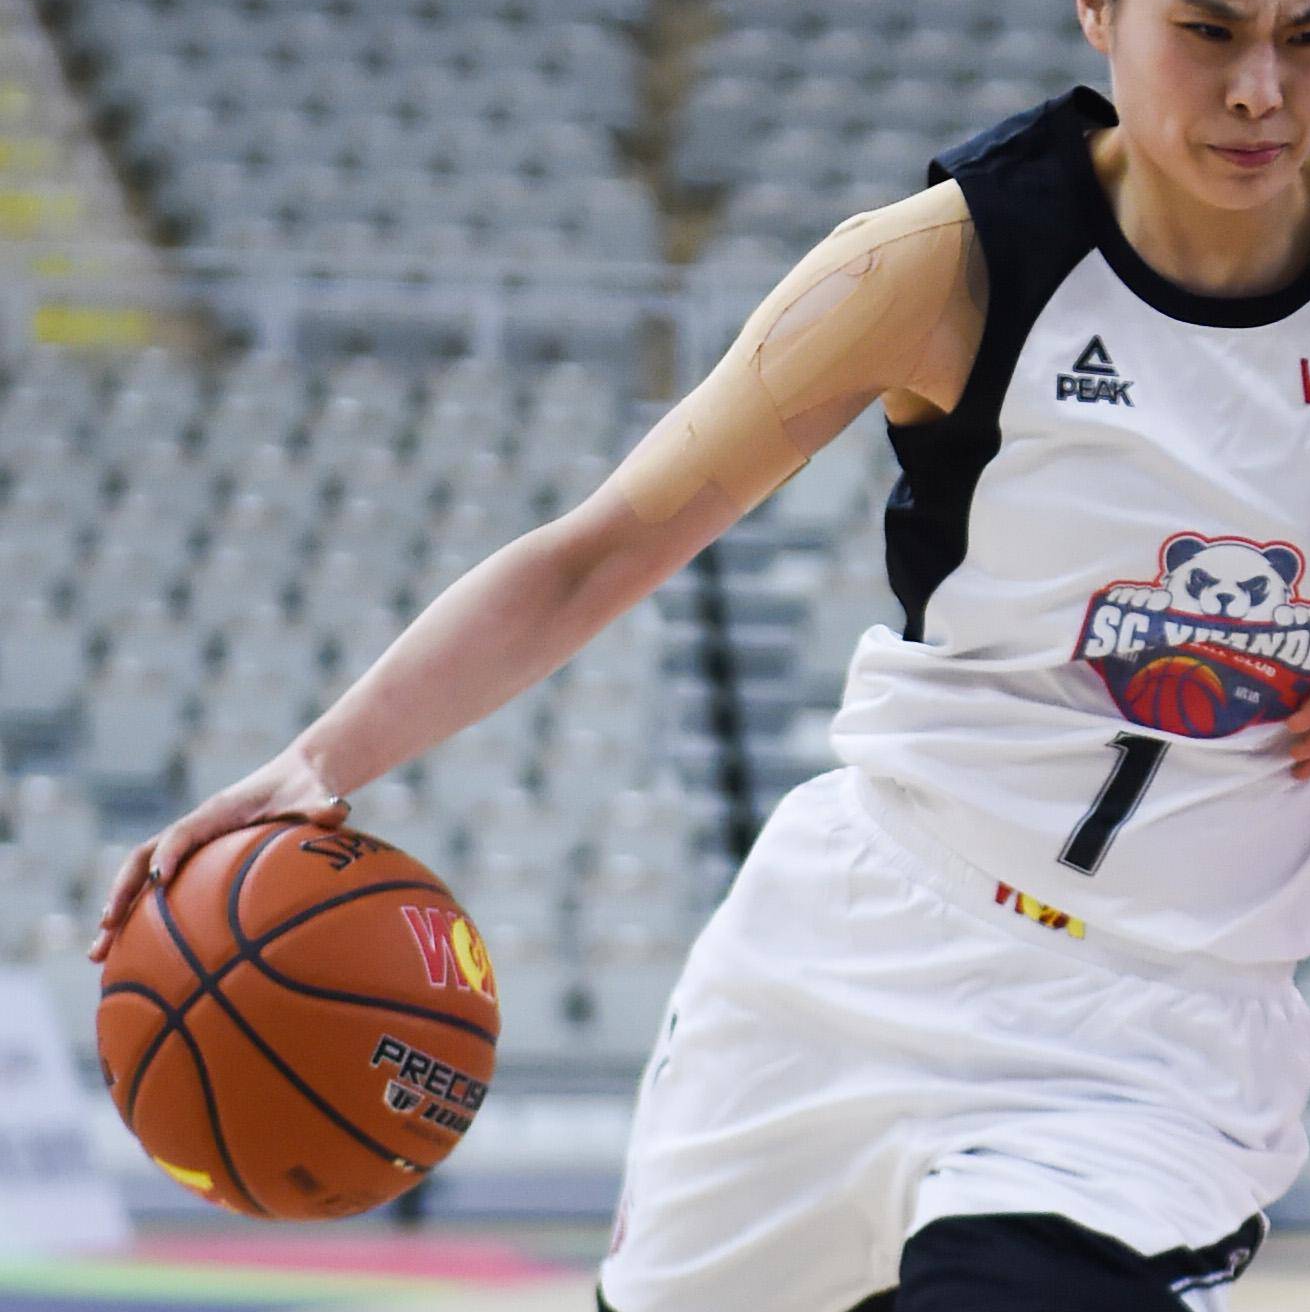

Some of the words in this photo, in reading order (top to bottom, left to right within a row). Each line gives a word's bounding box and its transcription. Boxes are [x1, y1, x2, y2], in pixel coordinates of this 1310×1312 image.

[1056, 373, 1136, 407] PEAK
[1085, 604, 1150, 660] SC
[1056, 730, 1172, 877] 1
